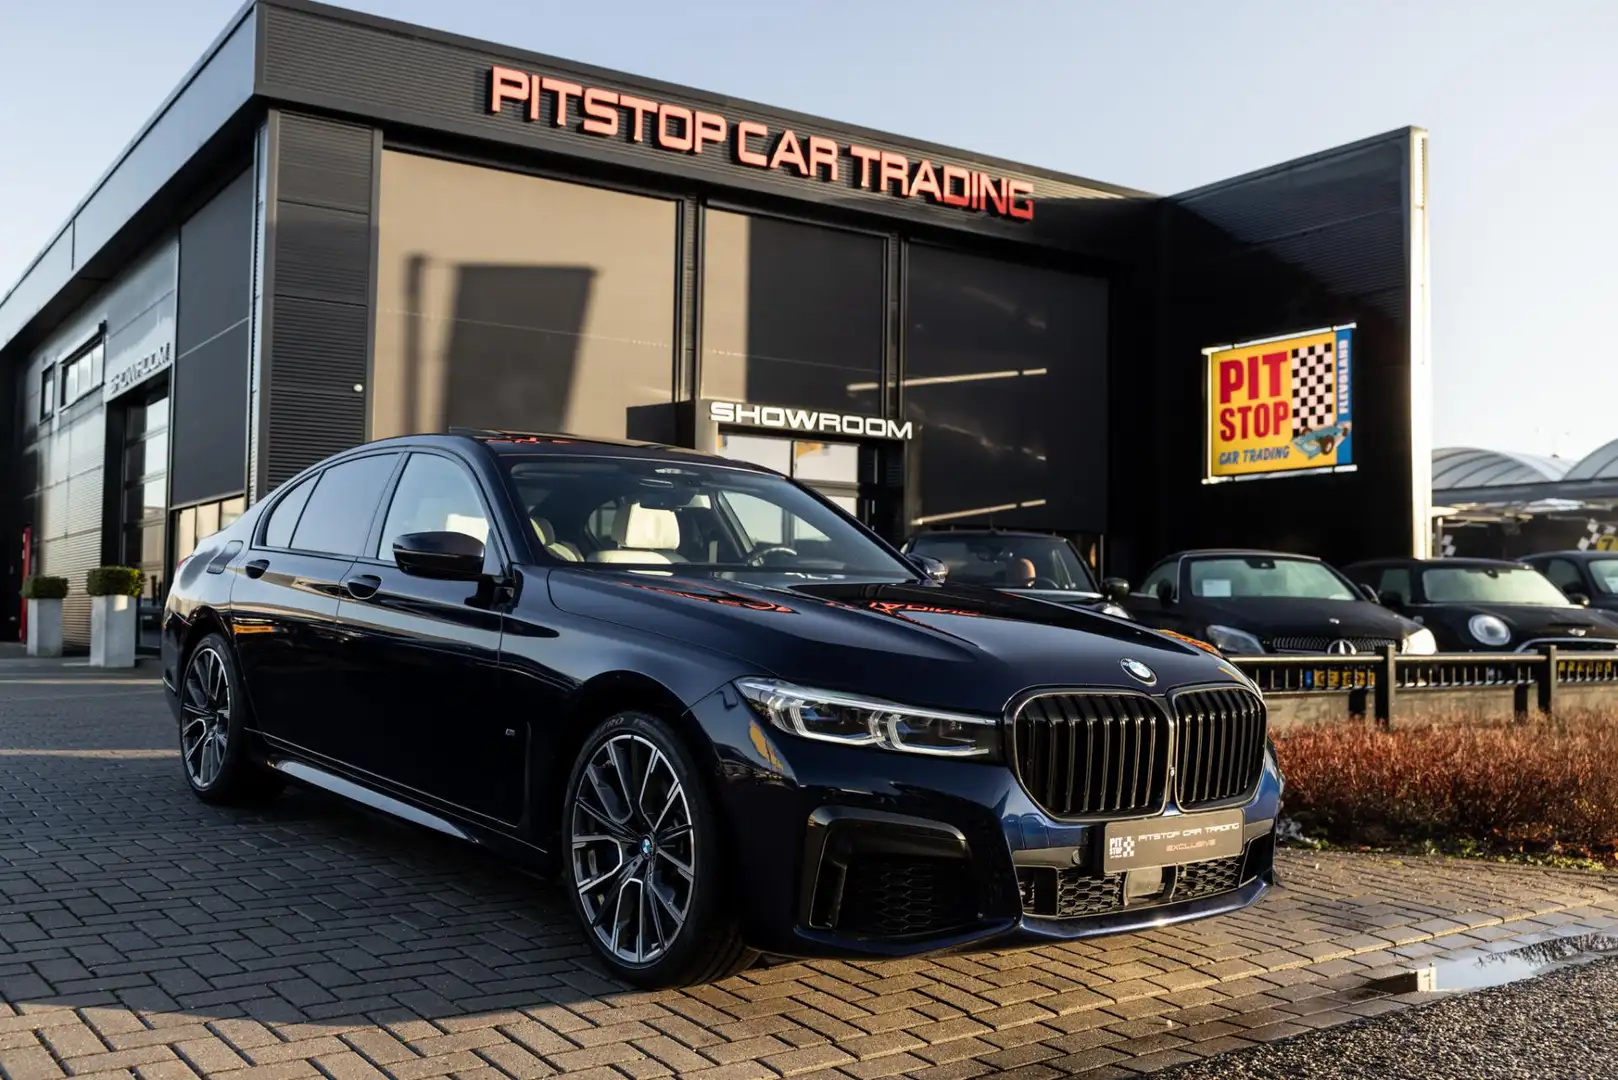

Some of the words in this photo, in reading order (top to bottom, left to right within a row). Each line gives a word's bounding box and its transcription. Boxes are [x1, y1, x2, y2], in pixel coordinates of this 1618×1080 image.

[490, 66, 727, 154] PITSTOP
[737, 120, 839, 182] CAR
[850, 144, 1035, 222] TRADING
[1219, 351, 1288, 404] PIT
[709, 401, 913, 440] SHOWROOM
[1219, 400, 1289, 442] STOP
[1219, 450, 1239, 465] CAR
[1243, 445, 1290, 463] TRADING
[1109, 837, 1123, 848] PIT
[1138, 830, 1181, 842] PITSTOP
[1182, 828, 1202, 838] CAR
[1205, 822, 1240, 833] TRADING
[1166, 838, 1216, 852] EXCLUSIVE
